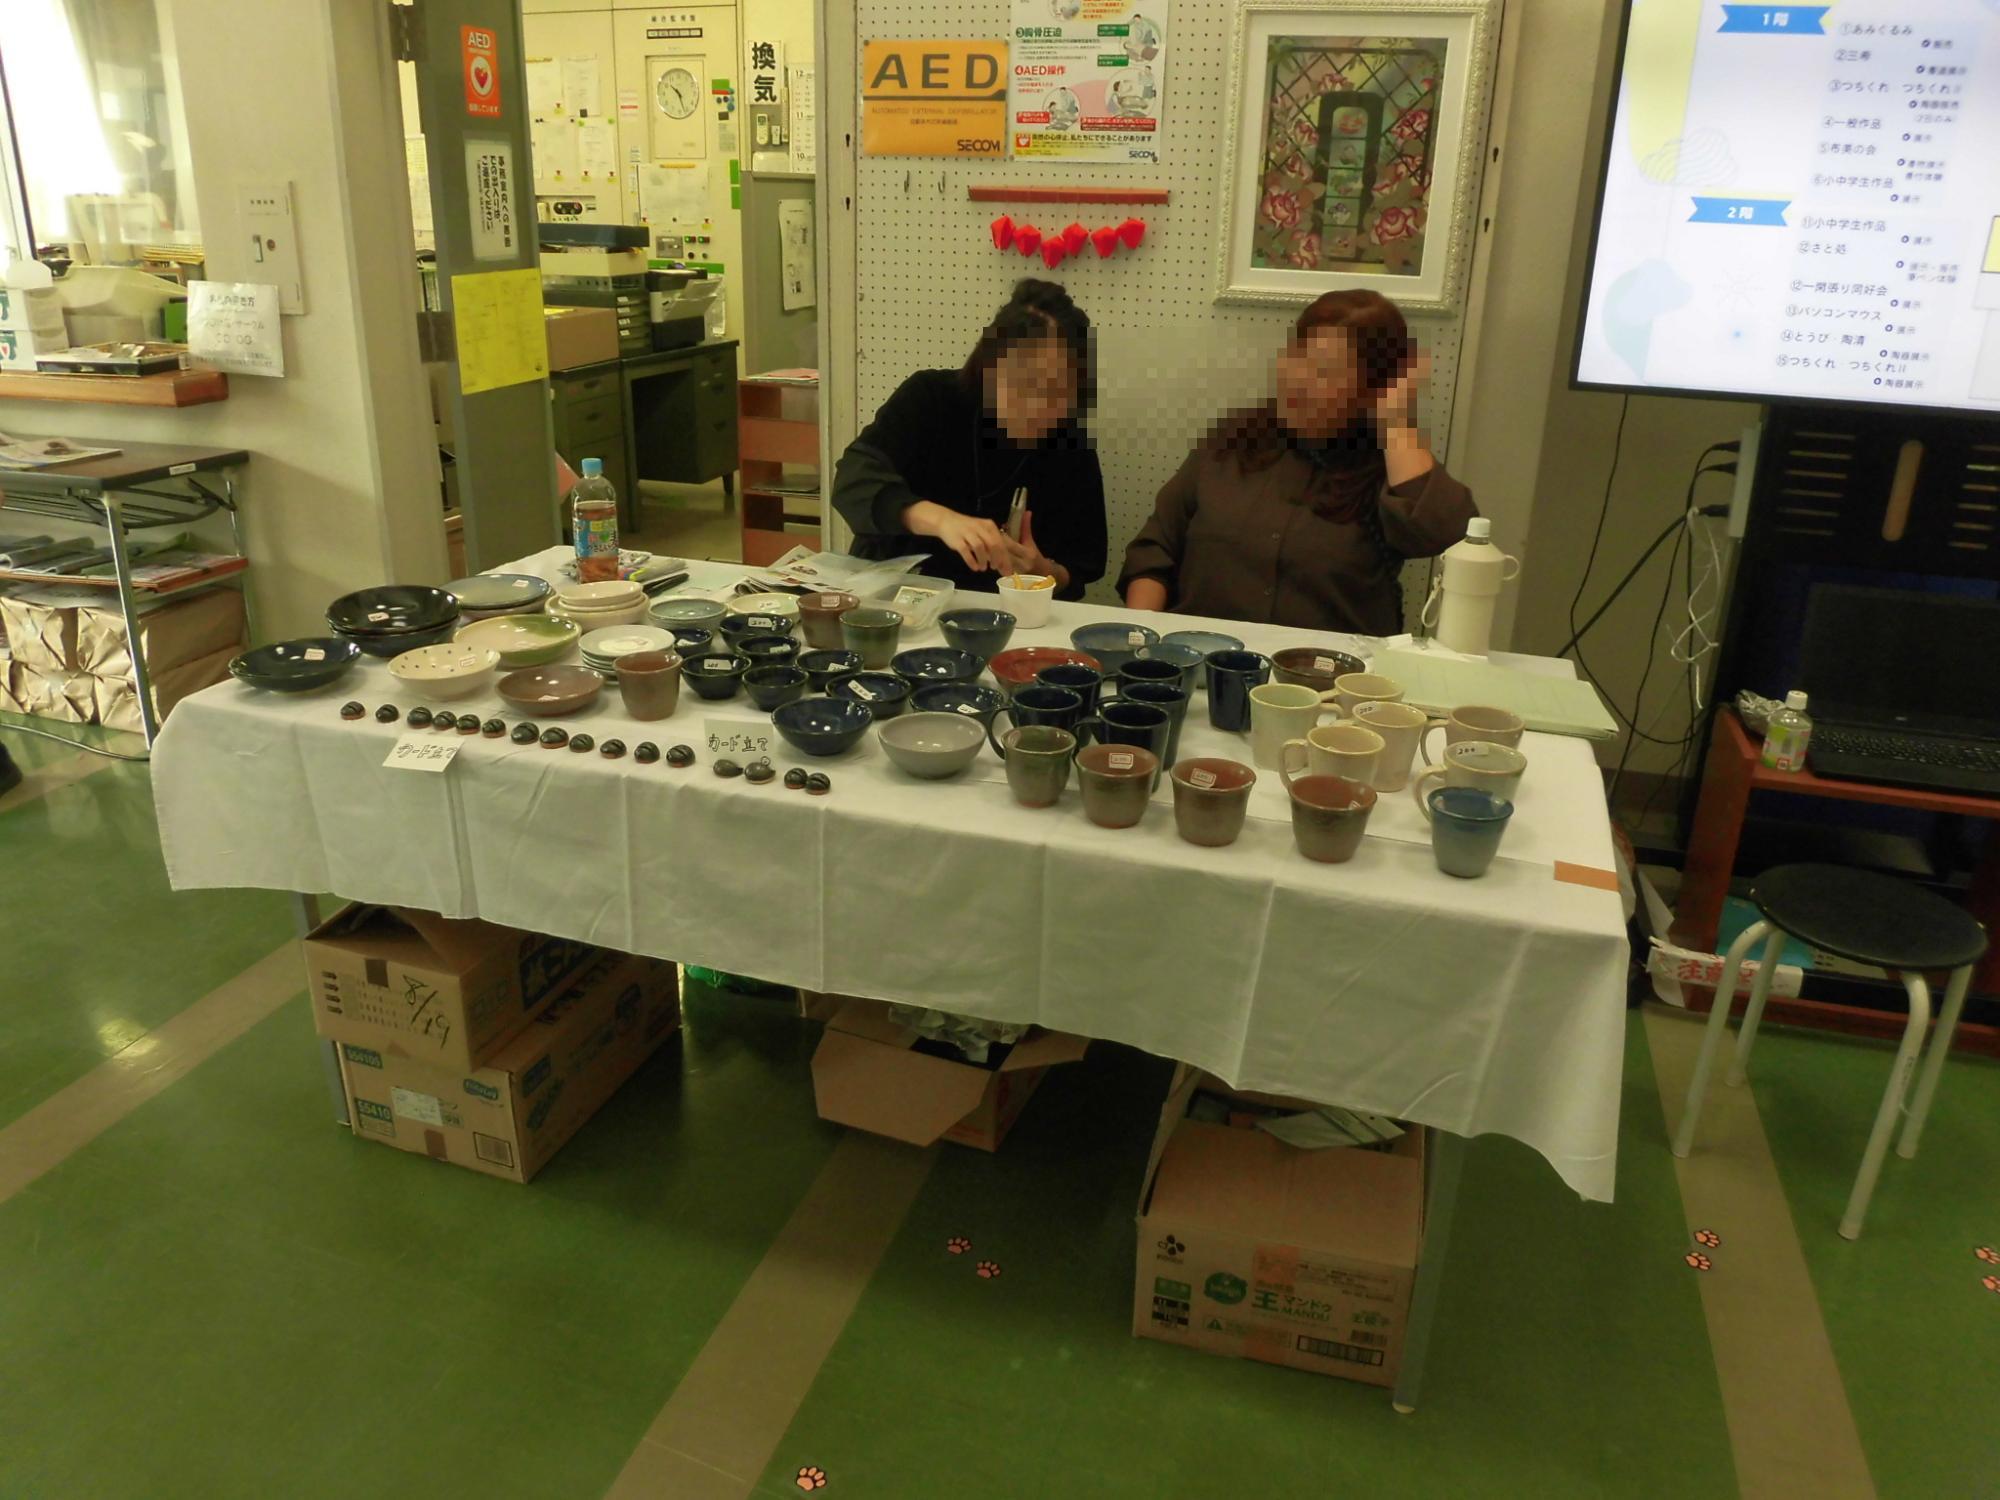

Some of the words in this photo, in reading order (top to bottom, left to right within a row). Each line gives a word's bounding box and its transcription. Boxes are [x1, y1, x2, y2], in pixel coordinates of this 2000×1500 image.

[1762, 11, 1790, 27] 1階
[467, 31, 491, 49] AED
[751, 41, 777, 103] 換気
[795, 69, 804, 77] 12
[870, 53, 999, 89] AED
[956, 139, 1001, 152] SECOM
[796, 152, 805, 160] 10
[1727, 206, 1754, 220] 2階
[708, 732, 769, 753] カード立て
